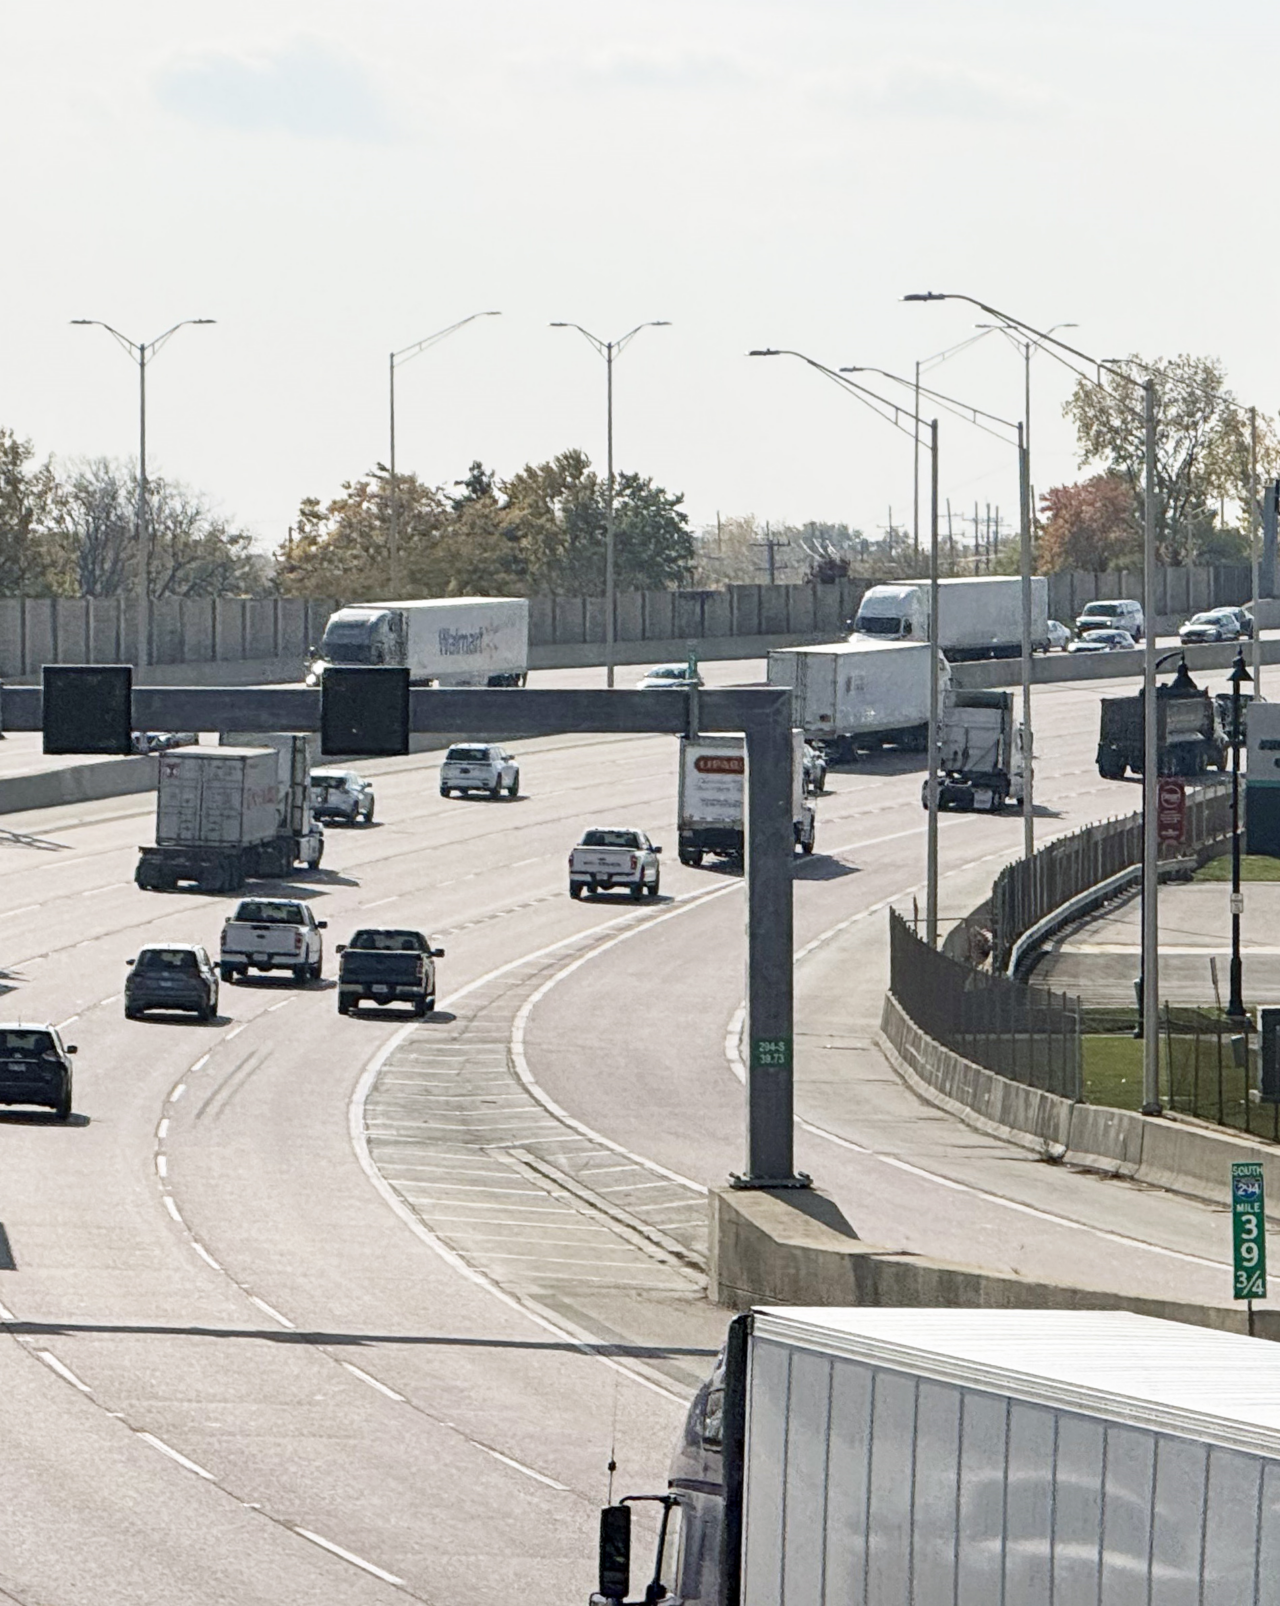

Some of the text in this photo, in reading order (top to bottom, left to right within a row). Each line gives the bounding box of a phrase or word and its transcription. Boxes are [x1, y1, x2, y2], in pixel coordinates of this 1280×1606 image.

[438, 626, 483, 656] Walmart
[759, 1041, 785, 1052] 294-S
[1232, 1165, 1263, 1176] SOUTH
[1238, 1183, 1260, 1195] 294
[1236, 1202, 1261, 1212] MILE
[1236, 1270, 1264, 1296] 3/4
